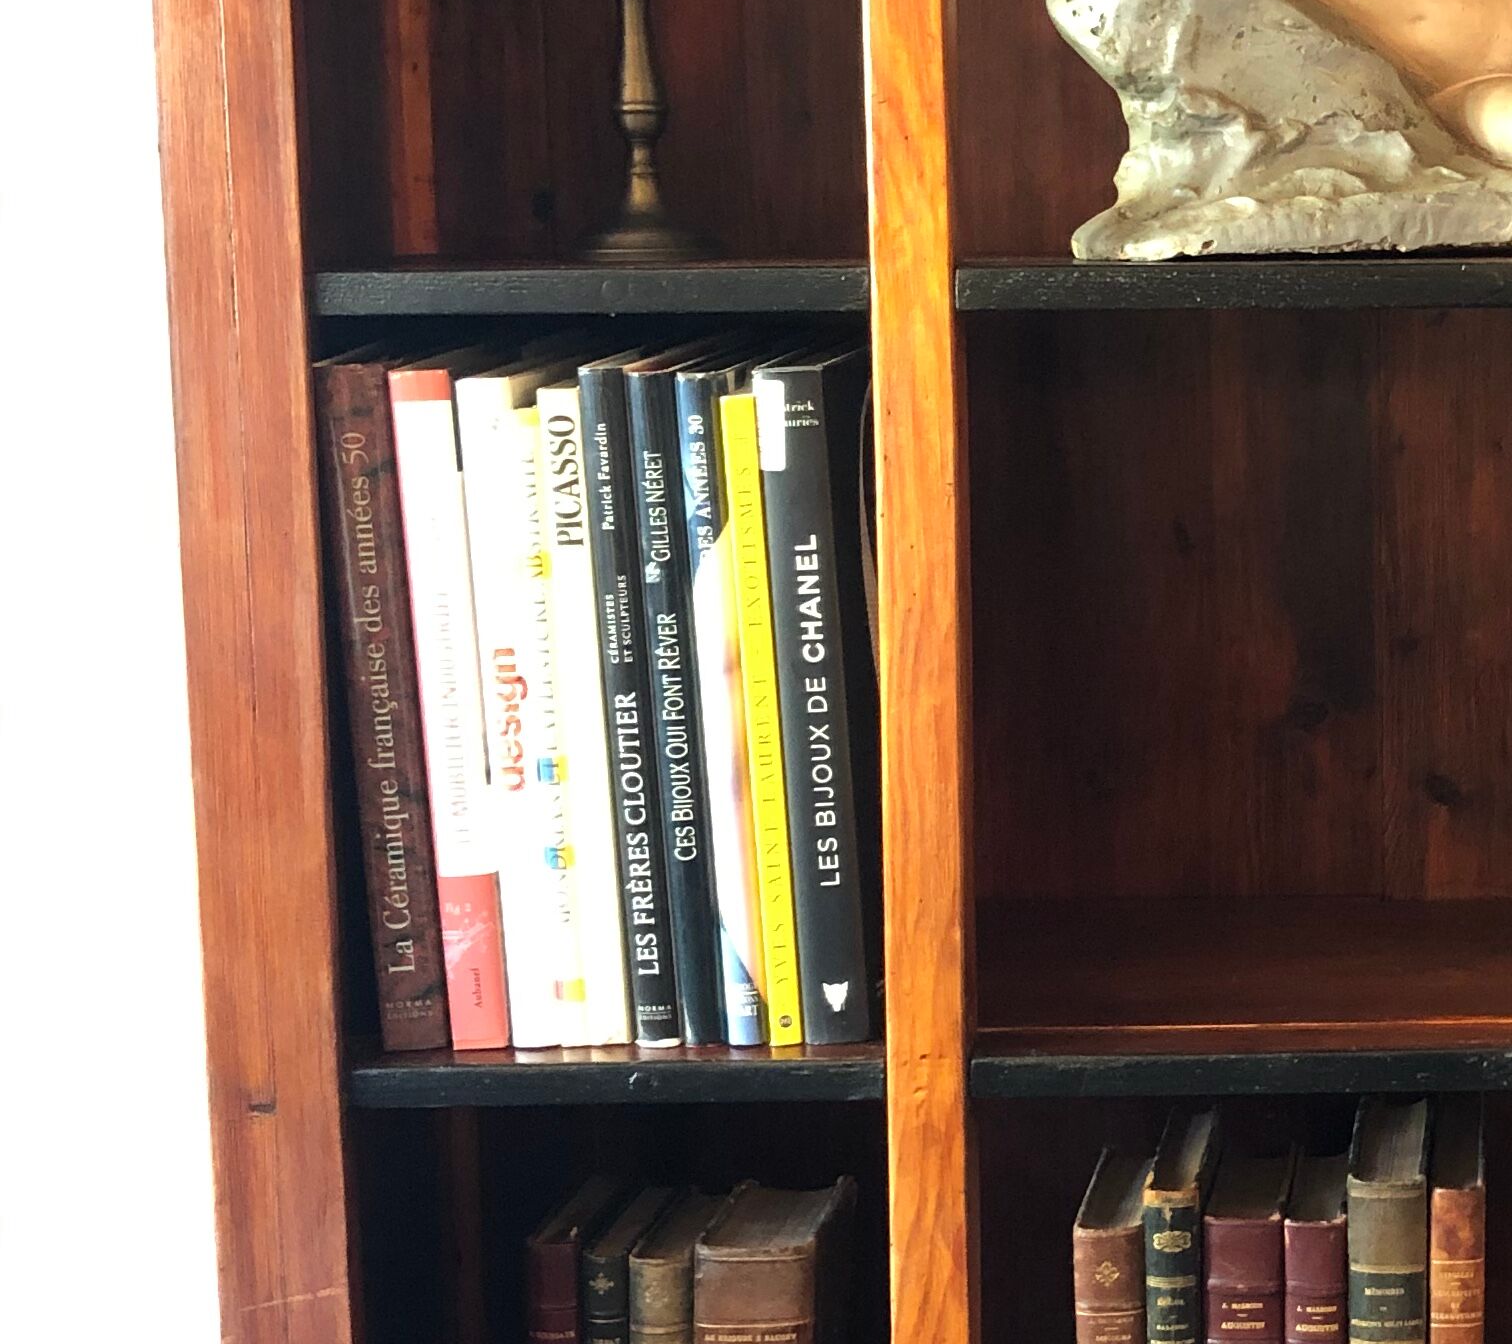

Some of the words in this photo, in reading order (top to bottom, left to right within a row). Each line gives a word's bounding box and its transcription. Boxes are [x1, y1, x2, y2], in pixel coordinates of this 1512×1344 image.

[341, 432, 369, 465] 50
[592, 423, 612, 480] Favardin
[642, 451, 666, 502] NÉRET
[548, 414, 584, 547] PICASSO
[598, 485, 615, 531] Patrick
[347, 476, 378, 574] années
[648, 506, 671, 562] GILLES
[353, 585, 384, 632] des
[617, 575, 632, 647] SCULPTEURS
[793, 534, 826, 664] CHANEL
[604, 594, 619, 664] CÉRAMISTES
[623, 650, 634, 663] ET
[654, 613, 681, 670] RÊVER
[361, 644, 399, 769] française
[493, 647, 528, 792] design
[661, 674, 686, 721] FONT
[804, 676, 828, 714] DE
[614, 691, 648, 826] CLOUTIER
[665, 726, 688, 759] QUI
[669, 762, 695, 822] BIJOUX
[808, 723, 837, 827] BIJOUX
[375, 779, 411, 930] Céramique
[673, 826, 698, 862] CES
[817, 837, 841, 887] LES
[625, 832, 655, 925] FRÈRES
[388, 939, 415, 974] La
[636, 933, 660, 976] LES
